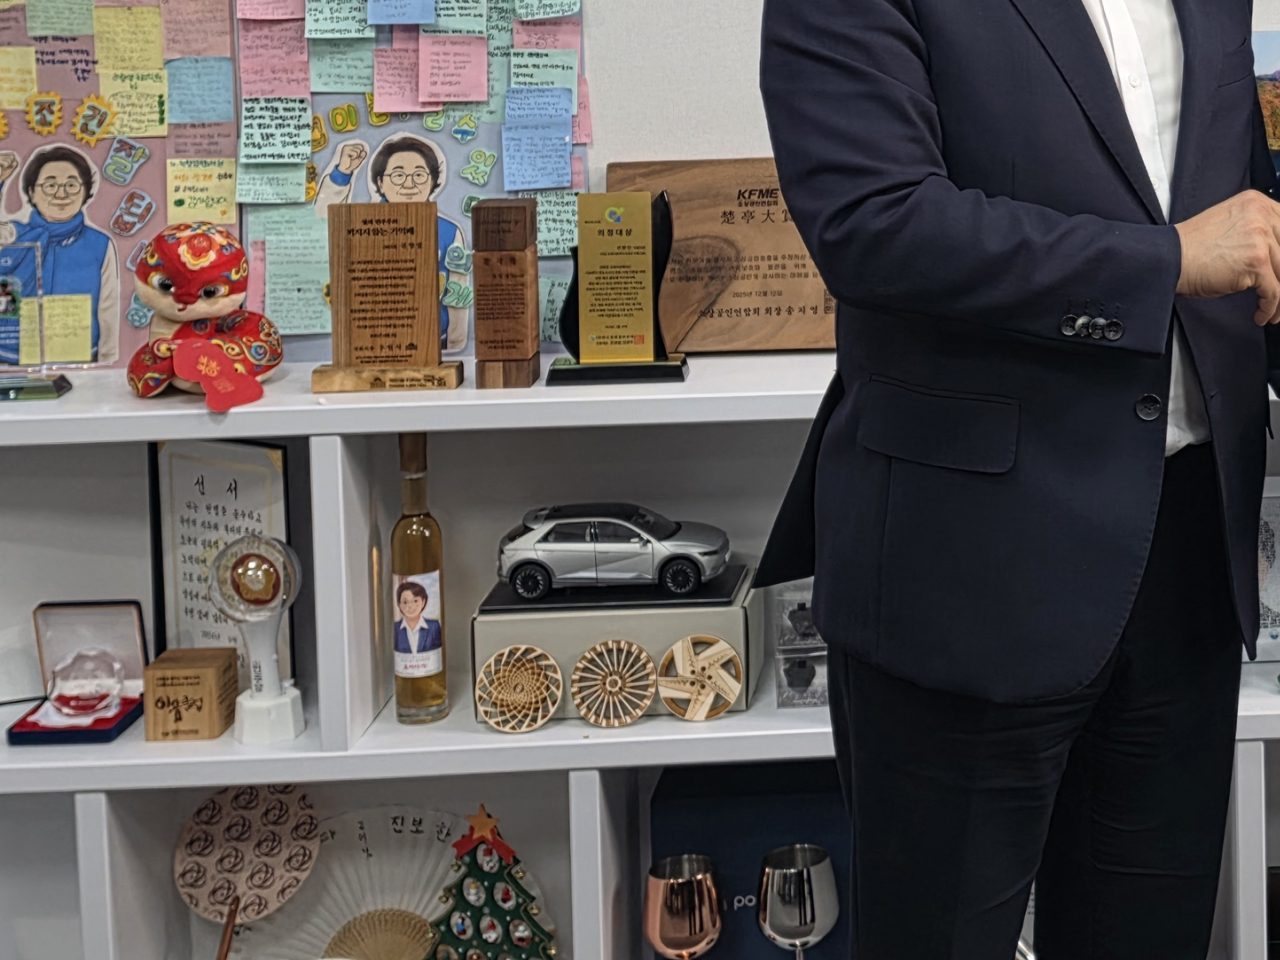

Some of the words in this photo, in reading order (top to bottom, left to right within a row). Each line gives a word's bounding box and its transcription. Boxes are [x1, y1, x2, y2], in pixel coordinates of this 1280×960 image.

[737, 188, 779, 200] KFME
[193, 473, 238, 501] 선서
[390, 815, 424, 835] 진보
